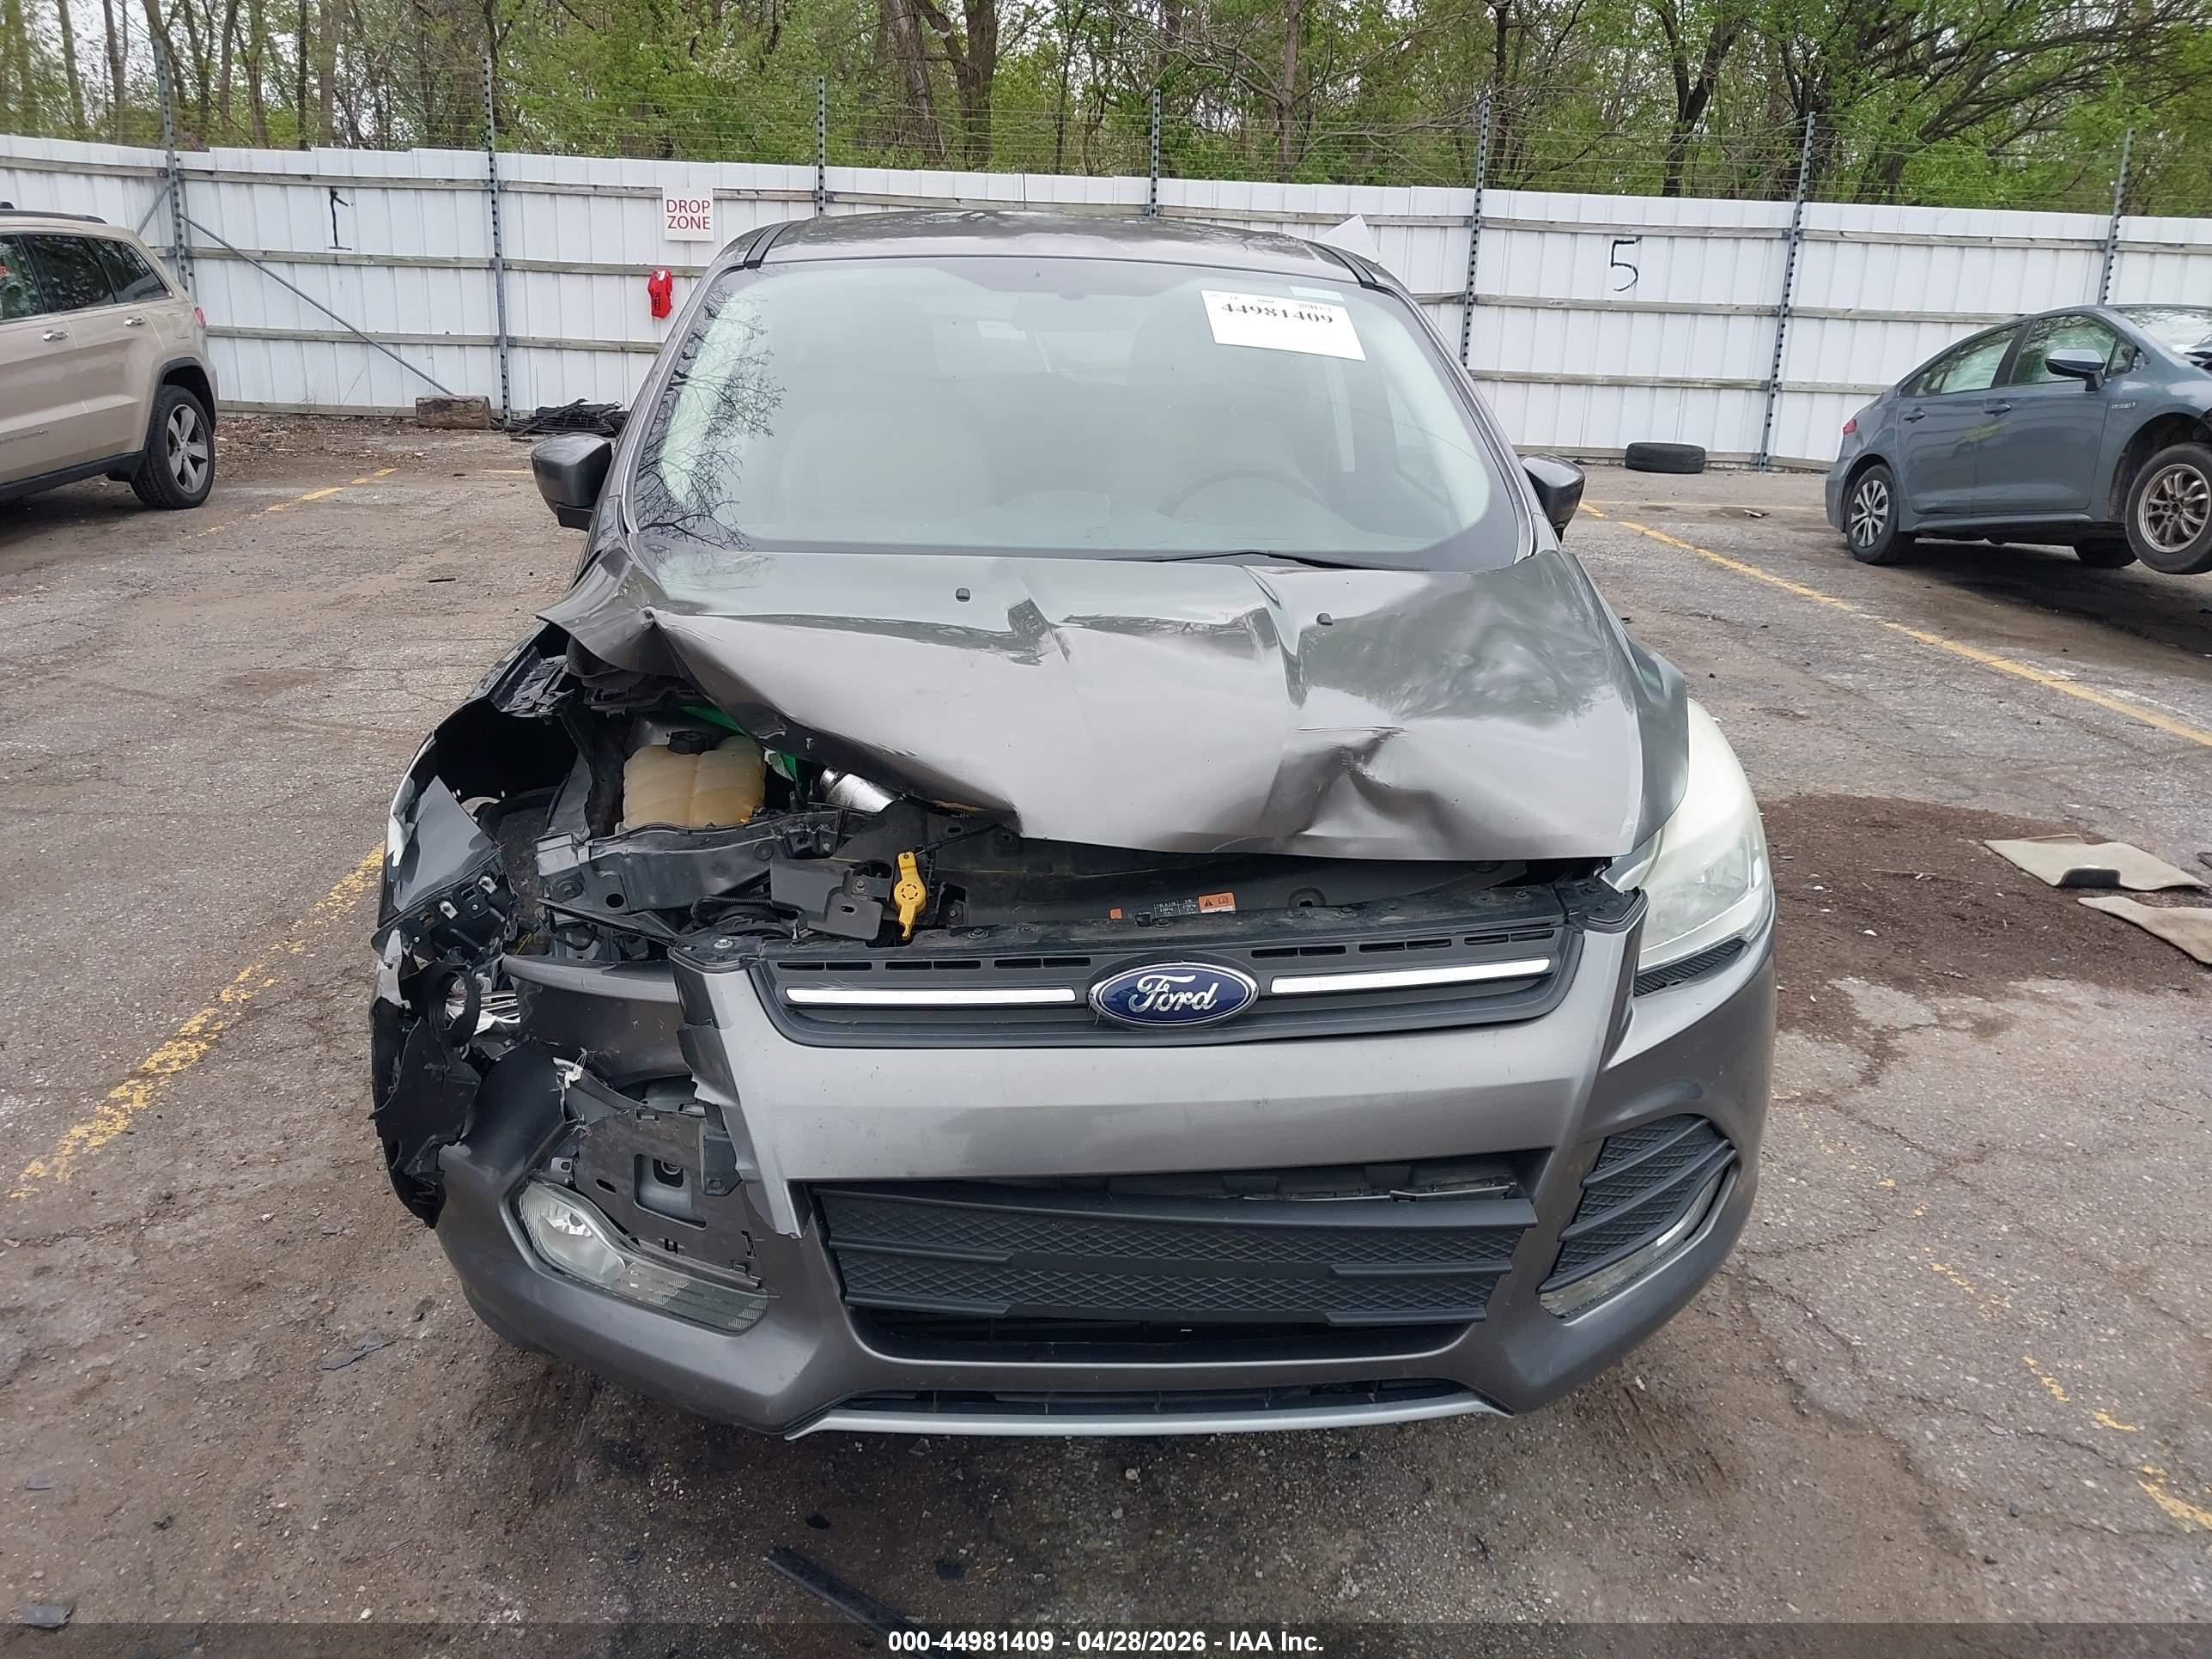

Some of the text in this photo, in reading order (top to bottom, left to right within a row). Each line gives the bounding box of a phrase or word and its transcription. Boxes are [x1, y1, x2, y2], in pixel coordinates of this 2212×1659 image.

[665, 199, 711, 214] DROP
[666, 216, 711, 230] ZONE
[1610, 237, 1642, 292] 5
[1221, 302, 1334, 324] 44981409
[1127, 974, 1220, 1013] Ford
